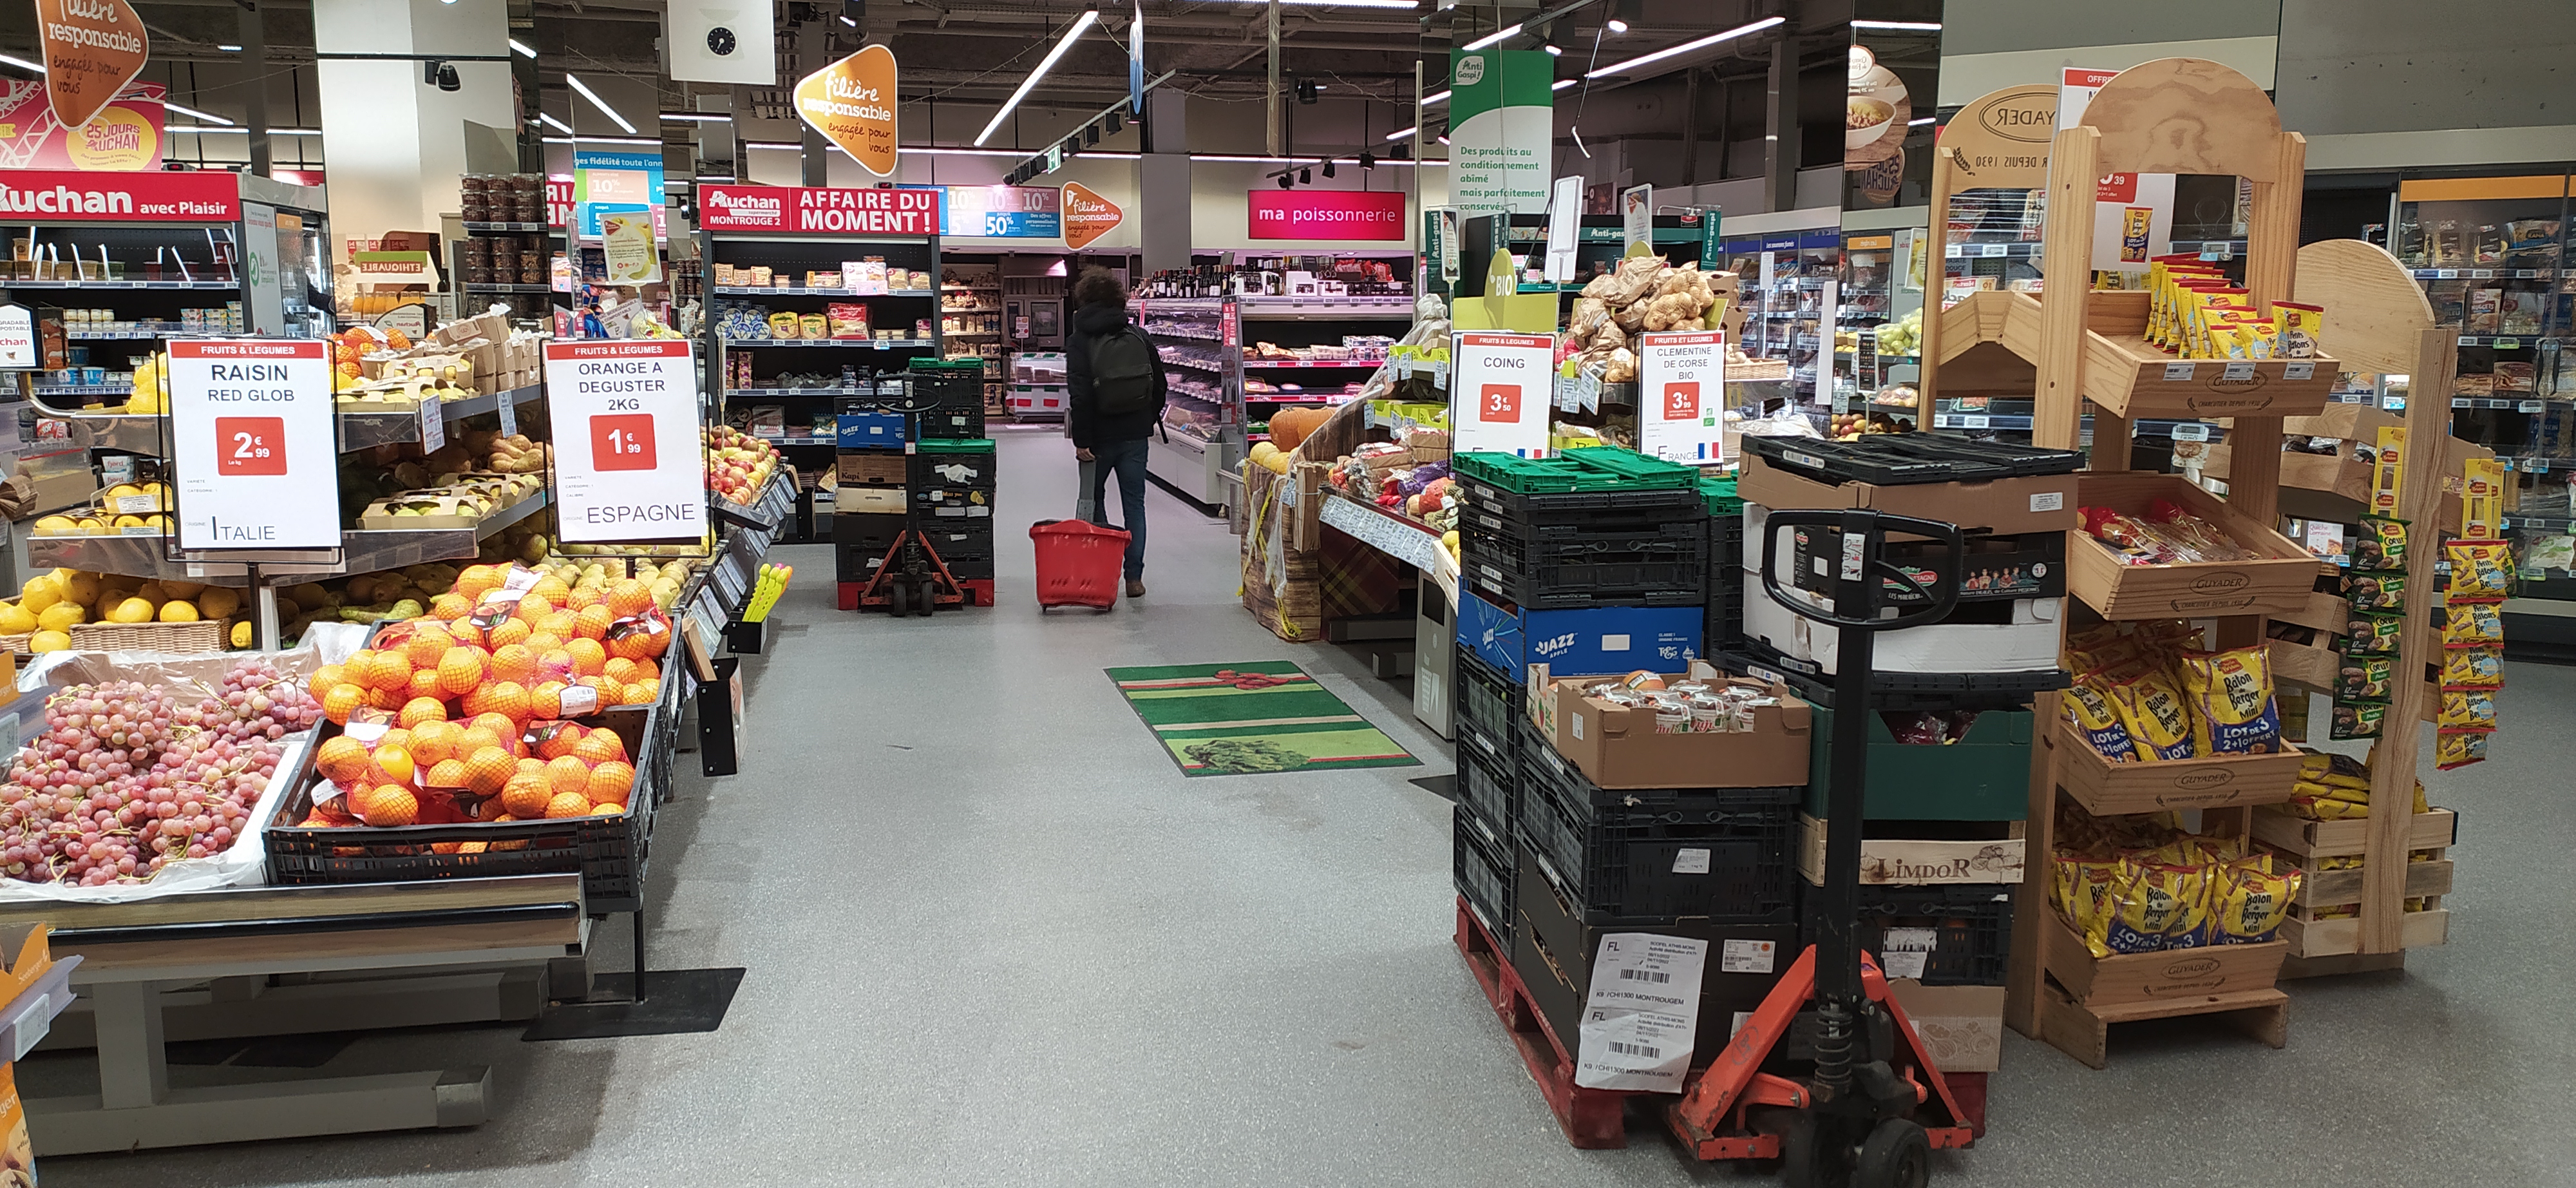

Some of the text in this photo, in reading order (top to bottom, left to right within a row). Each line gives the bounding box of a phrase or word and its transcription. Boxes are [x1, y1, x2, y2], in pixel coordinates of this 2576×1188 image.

[47, 22, 142, 53] responsable
[53, 53, 121, 82] engagée pour
[1463, 61, 1482, 71] Anti
[57, 79, 80, 95] vous
[825, 70, 880, 102] filière
[803, 97, 891, 121] responsable
[87, 122, 140, 139] 25 JOURS
[828, 122, 891, 142] engagée pour
[86, 134, 140, 151] AUCHAN
[869, 143, 890, 154] vous
[1461, 146, 1477, 155] Des
[1479, 147, 1518, 157] produits
[590, 157, 620, 166] fidélité
[1460, 174, 1489, 183] abîmé
[2114, 176, 2125, 185] 39
[0, 183, 133, 214] uchan
[709, 191, 781, 209] Auchan
[1459, 187, 1546, 199] mais parfaitement
[799, 191, 930, 210] AFFAIRE DU
[1023, 192, 1049, 211] 10%
[1074, 198, 1106, 215] filière
[1459, 202, 1504, 211] conservés
[140, 201, 227, 215] avec Plaisir
[710, 216, 773, 225] MONTROUGE
[801, 209, 918, 232] MOMENT
[1066, 213, 1119, 223] responsable
[1259, 207, 1396, 225] ma poissonnerie
[987, 216, 1014, 235] 50%
[1092, 224, 1106, 233] pour
[1431, 213, 1441, 259] Anti-gaspi
[1706, 212, 1716, 261] Anti-gaspi
[1495, 274, 1513, 296] BIO
[239, 346, 247, 354] &
[574, 347, 608, 356] FRUITS
[619, 345, 663, 354] LEGUMES
[1657, 347, 1712, 356] CLEMENTINE
[578, 362, 663, 375] ORANGE A
[1484, 357, 1526, 369] COING
[1678, 359, 1708, 368] CORSE
[1678, 371, 1694, 379] BIO
[579, 379, 666, 393] DEGUSTER
[208, 389, 295, 401] RED GLOB
[608, 398, 639, 410] 2KG
[841, 425, 859, 435] JAZZ
[1658, 446, 1698, 461] FRANCE
[841, 472, 860, 481] Kapi
[587, 503, 695, 524] ESPAGNE
[212, 516, 276, 541] ITALIE
[2196, 578, 2243, 589] GUYADER
[1482, 628, 1494, 646] JAZZ
[1535, 632, 1575, 656] JAZZ
[1549, 647, 1568, 659] APPLE
[2223, 673, 2252, 694] Bâton
[2145, 693, 2170, 716] Bâton
[2229, 690, 2261, 712] Berger
[2098, 714, 2112, 725] Mini
[2157, 707, 2181, 733] Berger
[2240, 707, 2259, 721] Mini
[2171, 723, 2186, 740] Mini
[2223, 717, 2269, 739] LOT 3
[2093, 733, 2112, 745] LOT
[2181, 773, 2228, 785] GUYADER
[2146, 886, 2172, 901] Bâton
[2244, 892, 2272, 907] Bâton
[2144, 905, 2172, 921] Berger
[2241, 908, 2270, 925] Berger
[2145, 921, 2162, 932] Mini
[2244, 924, 2260, 935] Mini
[1607, 941, 1620, 952] FL
[2168, 962, 2214, 975] GUYADER
[1635, 993, 1684, 1005] MONTROUGEM
[1592, 1011, 1606, 1021] FL
[1625, 1069, 1673, 1077] MONTROUGEM
